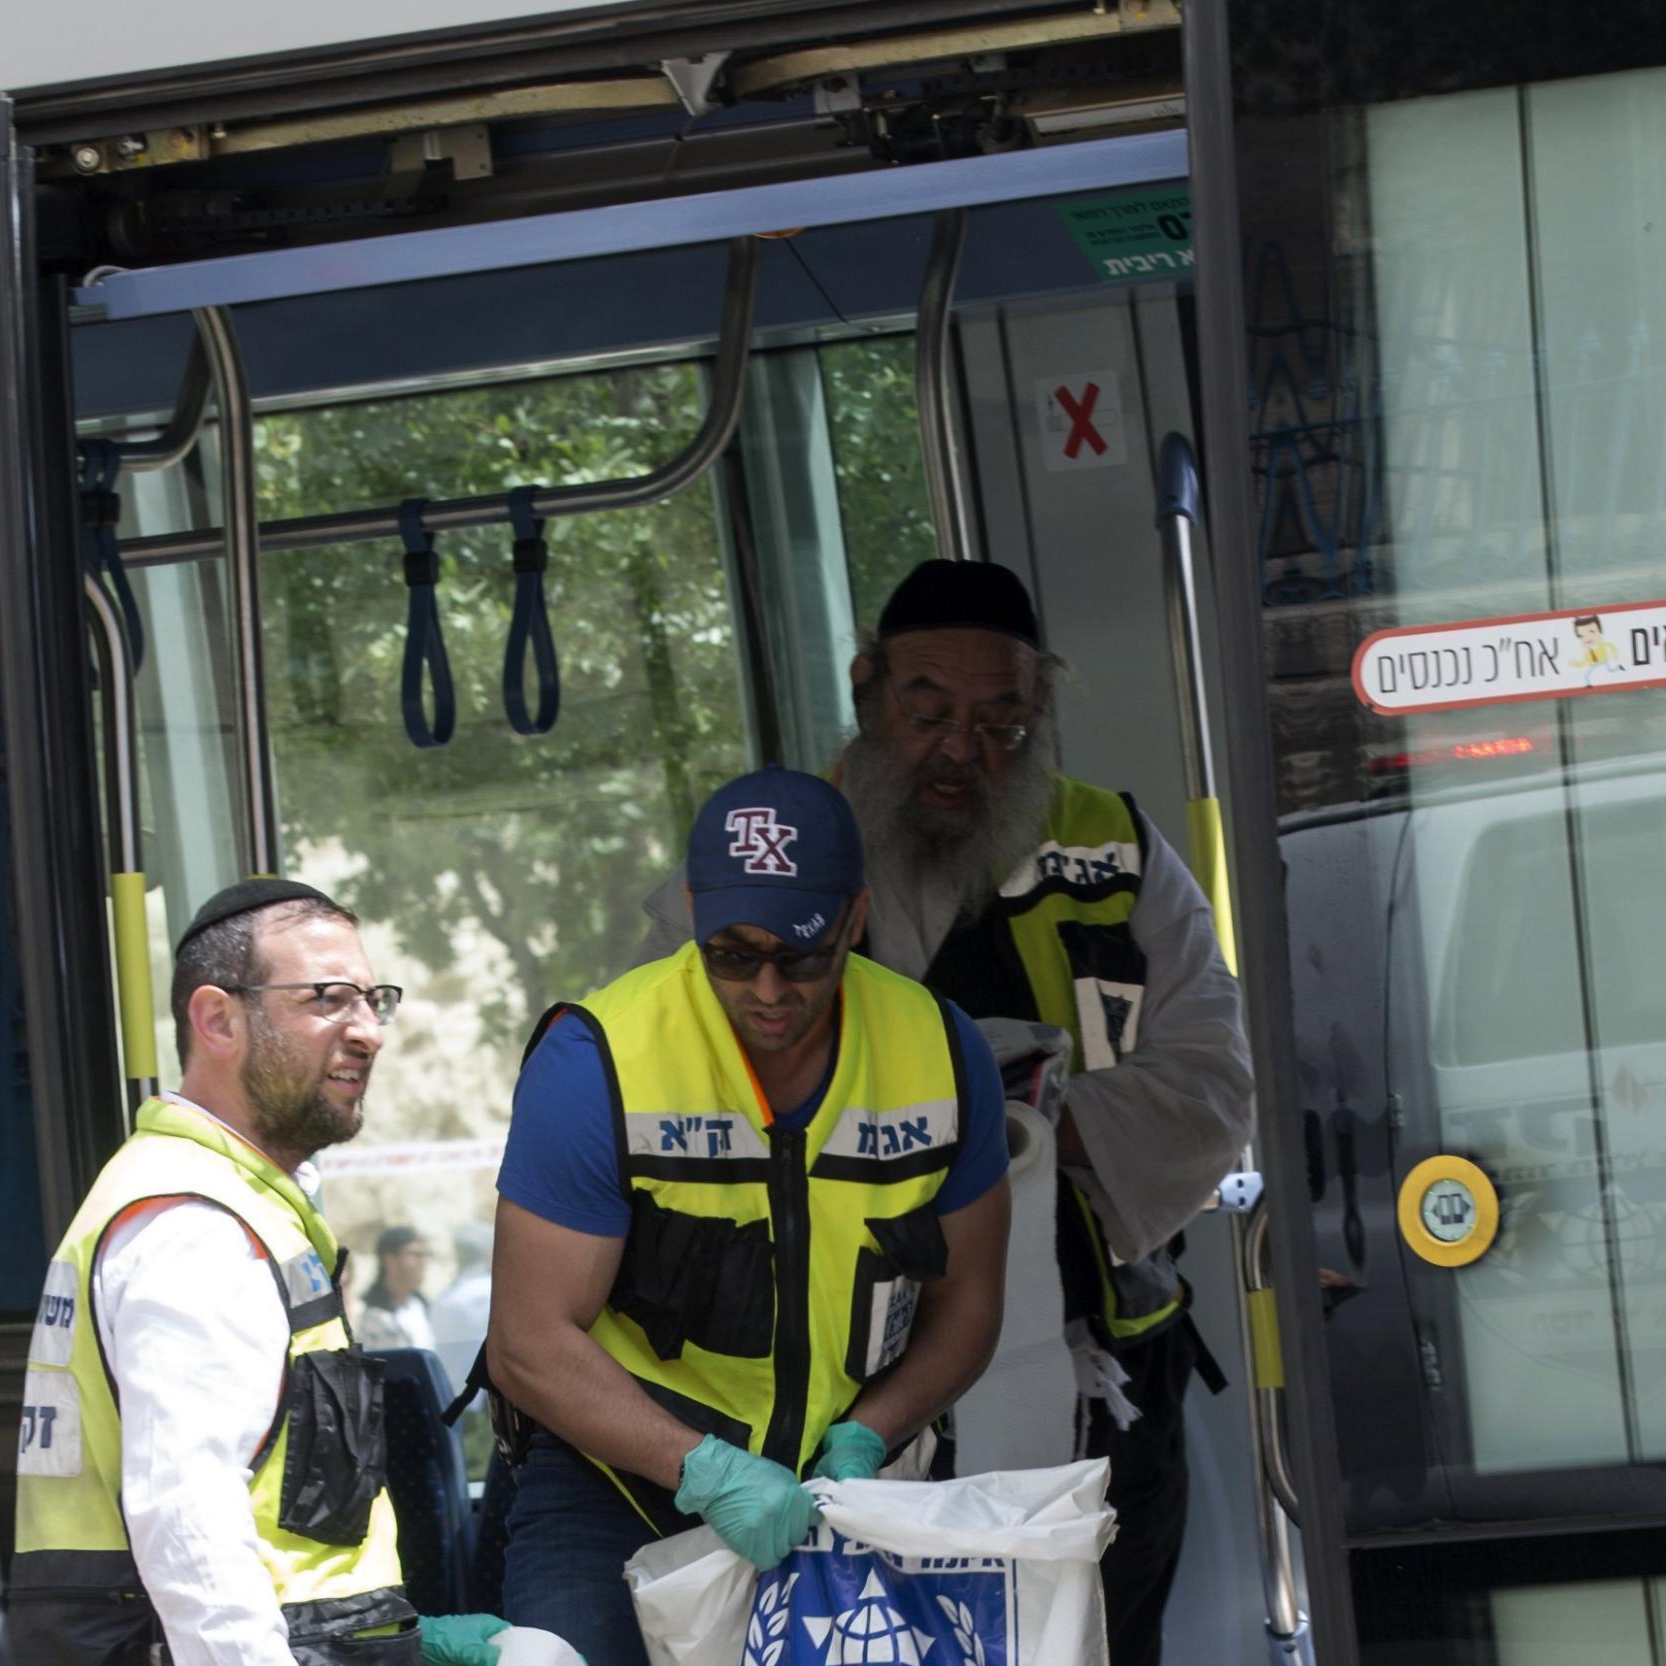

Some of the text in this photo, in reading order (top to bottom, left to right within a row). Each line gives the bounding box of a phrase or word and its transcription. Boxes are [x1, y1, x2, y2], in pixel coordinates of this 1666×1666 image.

[1103, 251, 1176, 275] ריבית
[1376, 646, 1473, 694] נכנסים
[725, 807, 798, 877] TX
